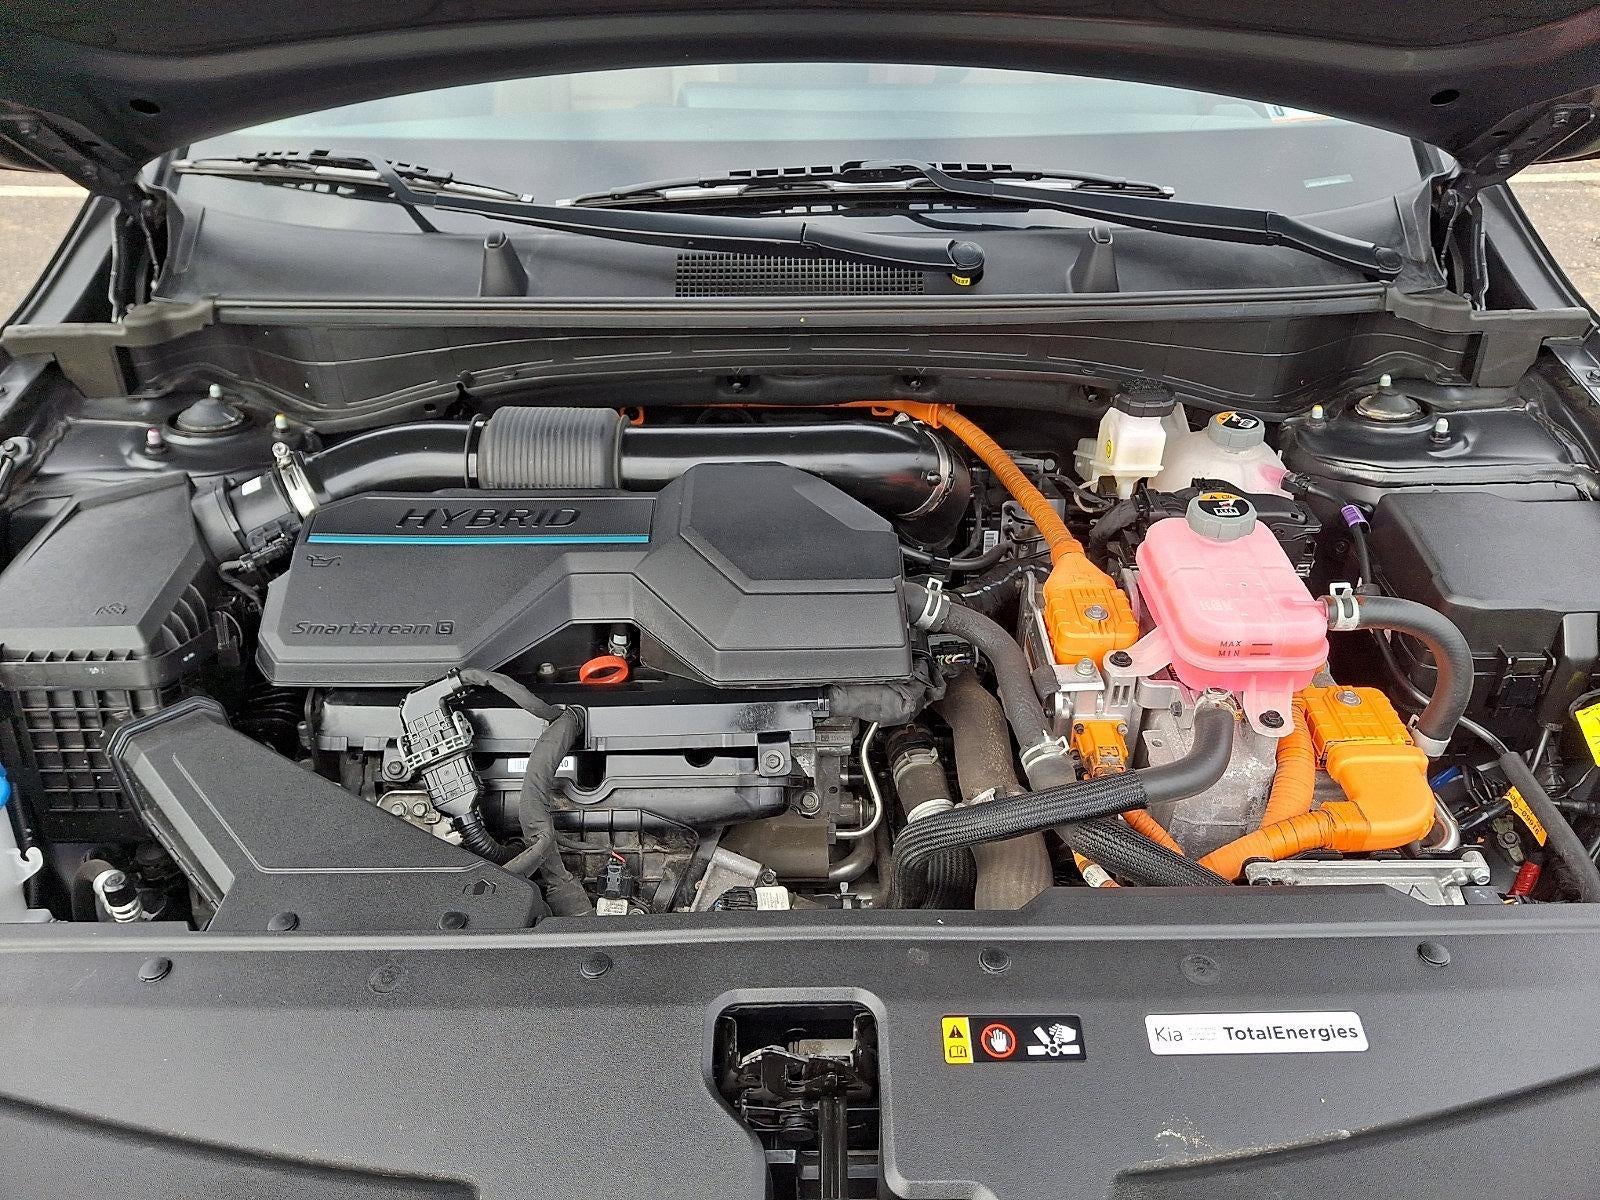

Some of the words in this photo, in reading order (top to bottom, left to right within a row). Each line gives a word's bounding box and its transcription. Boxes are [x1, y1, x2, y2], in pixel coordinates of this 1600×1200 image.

[395, 508, 582, 529] HYBRID
[291, 620, 433, 635] Smartstream
[1219, 640, 1242, 648] MAX
[1154, 1026, 1184, 1042] Kia
[1222, 1024, 1359, 1042] TotalEnergies
